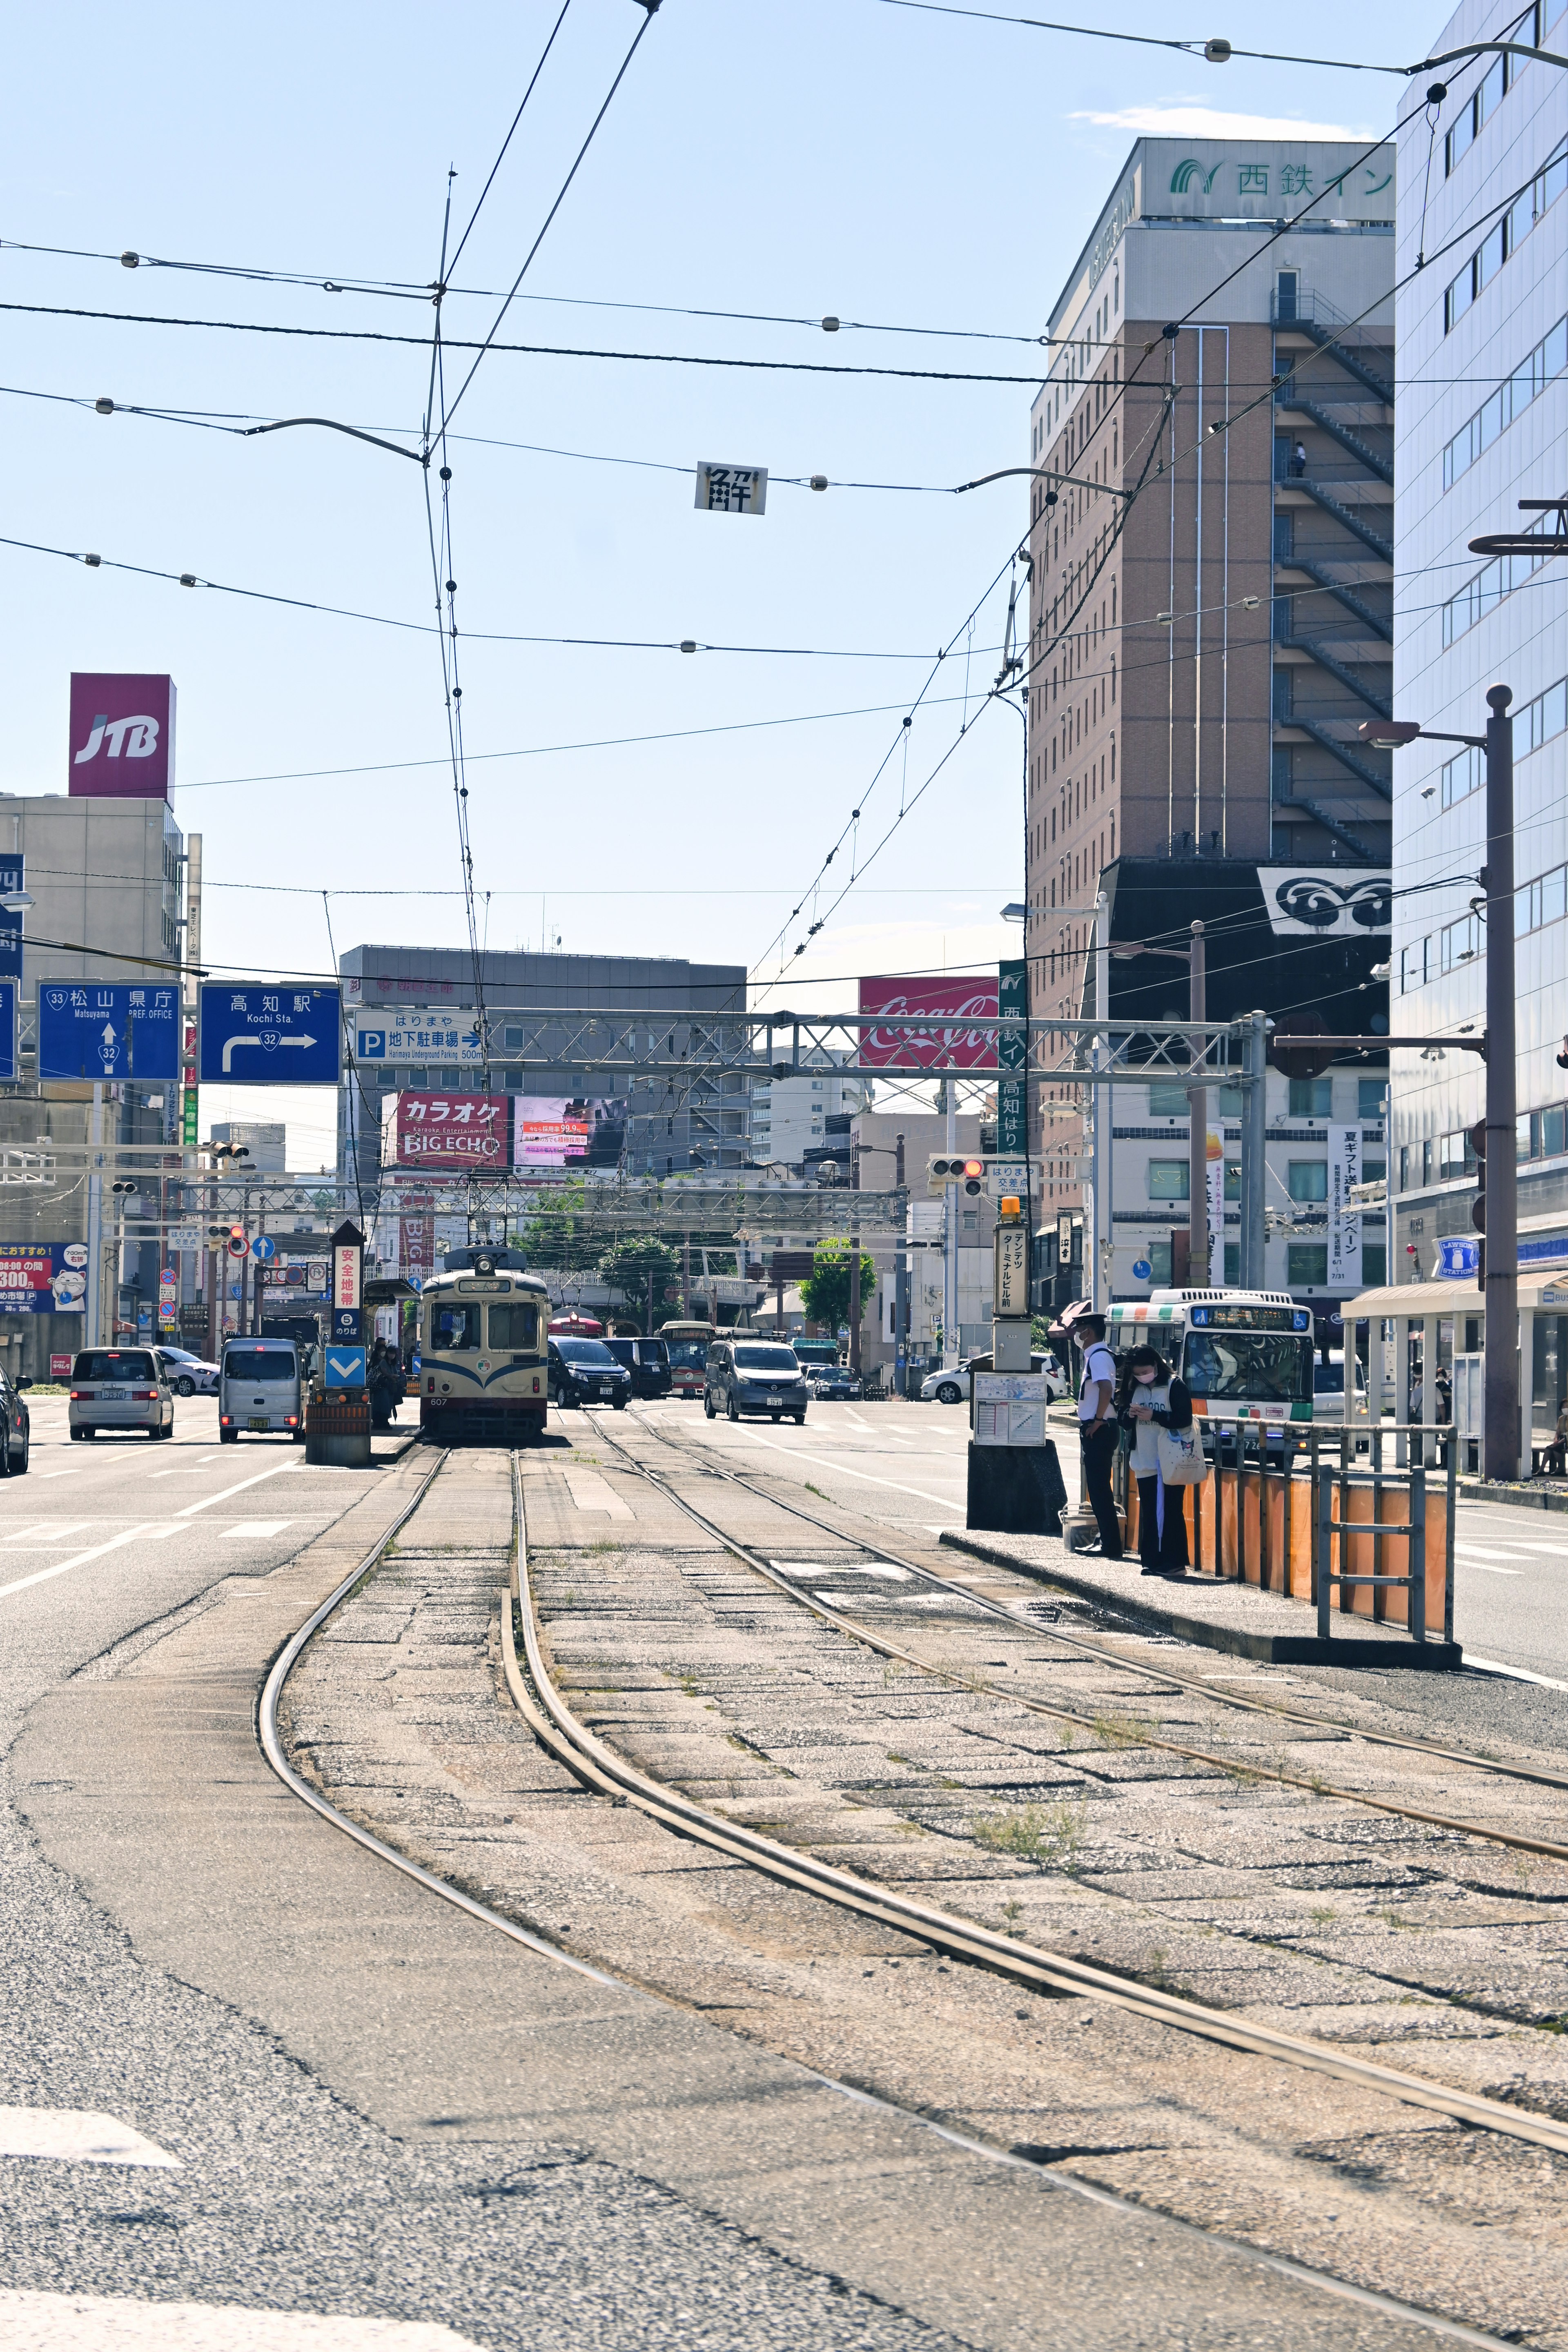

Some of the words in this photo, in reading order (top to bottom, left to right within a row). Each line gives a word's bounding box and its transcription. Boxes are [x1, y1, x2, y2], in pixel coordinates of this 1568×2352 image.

[1237, 163, 1393, 196] 西鉄イン
[74, 714, 160, 764] JTB
[51, 993, 63, 1004] 33
[70, 990, 113, 1007] 松山
[129, 991, 173, 1008] 県庁
[230, 995, 311, 1012] 高知駅
[75, 1009, 109, 1020] Matsuyama
[129, 1009, 147, 1019] PREF.
[149, 1010, 172, 1019] OFFICE
[247, 1014, 273, 1023] Kochi
[276, 1014, 294, 1023] Sta.
[396, 1016, 452, 1027] はりまや
[263, 1034, 275, 1045] 32
[365, 1033, 380, 1055] P
[389, 1031, 459, 1047] 地下駐車場
[103, 1047, 115, 1058] 32
[389, 1050, 410, 1058] Harimaya
[412, 1050, 440, 1060] Underground
[441, 1050, 458, 1060] Parking
[461, 1050, 483, 1059] 500m
[407, 1101, 500, 1124] カラオケ
[404, 1136, 441, 1155] BIG
[446, 1136, 500, 1156] ECHO
[993, 1167, 1034, 1176] はりまや
[998, 1178, 1028, 1187] 交差点
[1014, 1233, 1024, 1269] デンテツ
[341, 1249, 354, 1305] 安全地帯
[1002, 1235, 1012, 1307] ターミナルビル前
[430, 1398, 448, 1406] 607
